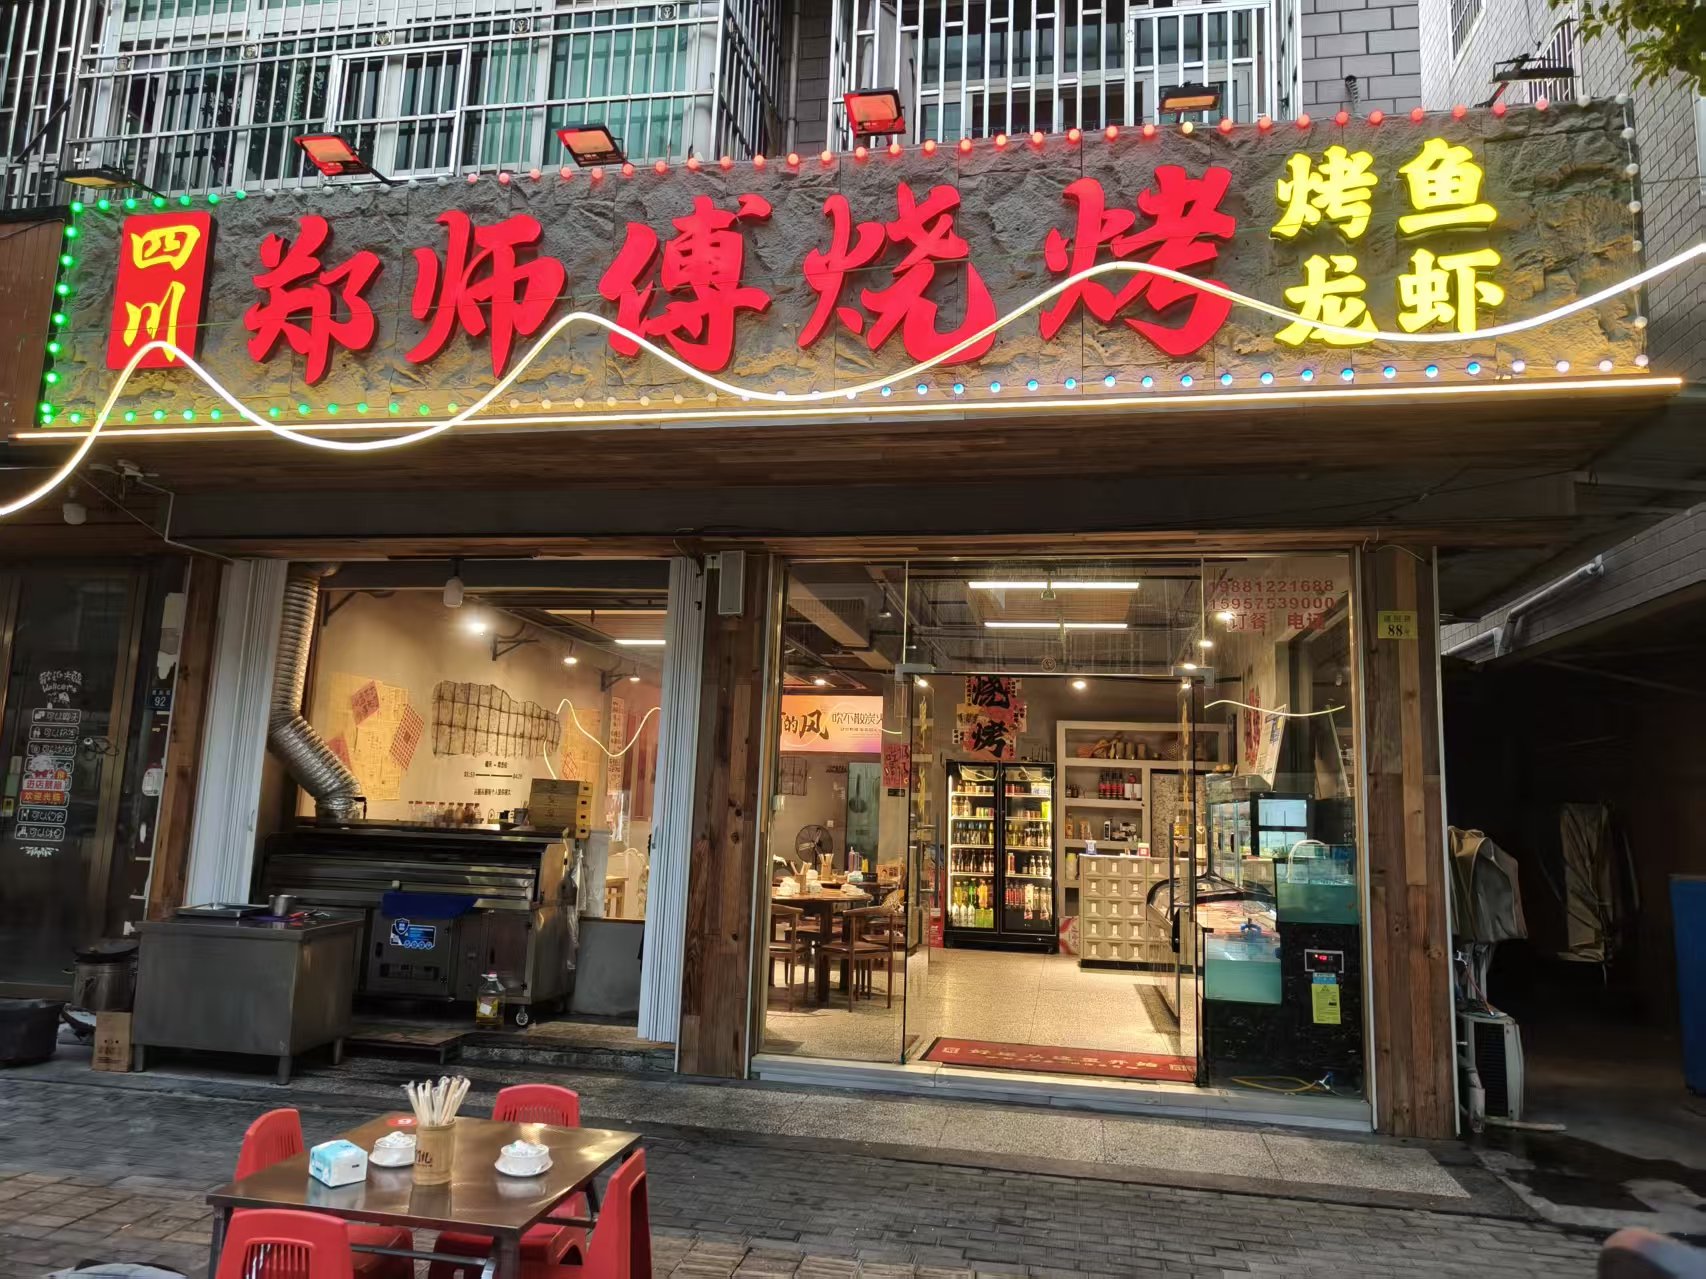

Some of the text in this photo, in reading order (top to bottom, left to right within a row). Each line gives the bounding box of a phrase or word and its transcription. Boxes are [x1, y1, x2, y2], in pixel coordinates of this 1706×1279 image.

[1269, 137, 1499, 241] 烤鱼
[124, 223, 201, 363] 四川
[242, 165, 1237, 386] 郑师傅烧烤
[1275, 248, 1506, 348] 龙虾
[1211, 597, 1335, 610] 15957539000
[1231, 613, 1267, 630] 订餐
[154, 696, 166, 707] 92
[780, 709, 829, 740] 的风
